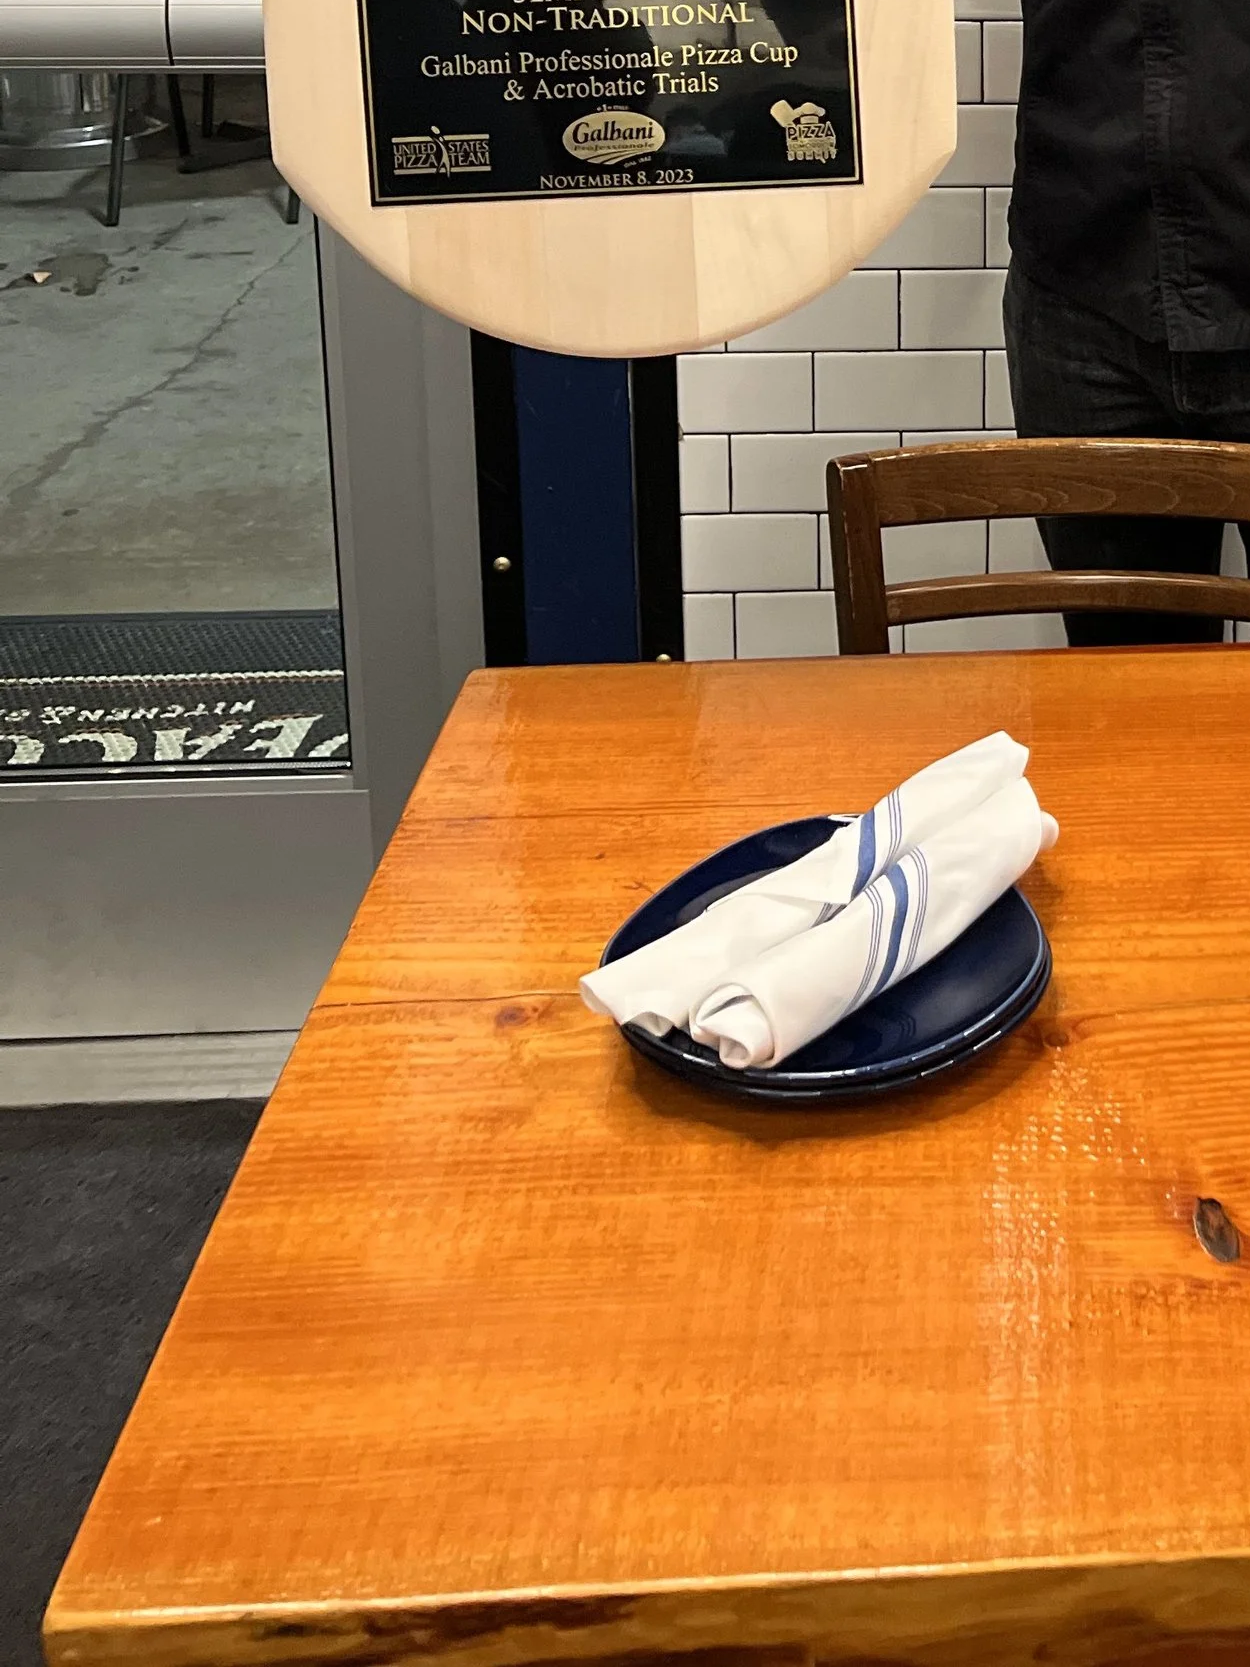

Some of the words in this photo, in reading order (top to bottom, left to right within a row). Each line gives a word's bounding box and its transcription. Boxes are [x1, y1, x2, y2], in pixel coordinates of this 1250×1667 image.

[461, 1, 755, 36] NON-TRADITIONAL
[420, 50, 511, 78] Galbani
[519, 45, 674, 74] Professionale
[681, 44, 743, 66] Pizza
[749, 42, 799, 68] Cup
[503, 79, 525, 101] &
[532, 76, 646, 100] Acrobatic
[652, 71, 719, 95] Trials
[572, 121, 654, 144] Galbani
[787, 124, 835, 140] PIZZA
[393, 142, 436, 155] UNITED
[448, 140, 489, 153] STATES
[574, 142, 655, 152] Professionale
[394, 153, 438, 169] PIZZA
[449, 151, 490, 166] TEAM
[540, 173, 633, 190] NOVEMBER
[656, 169, 694, 184] 2023
